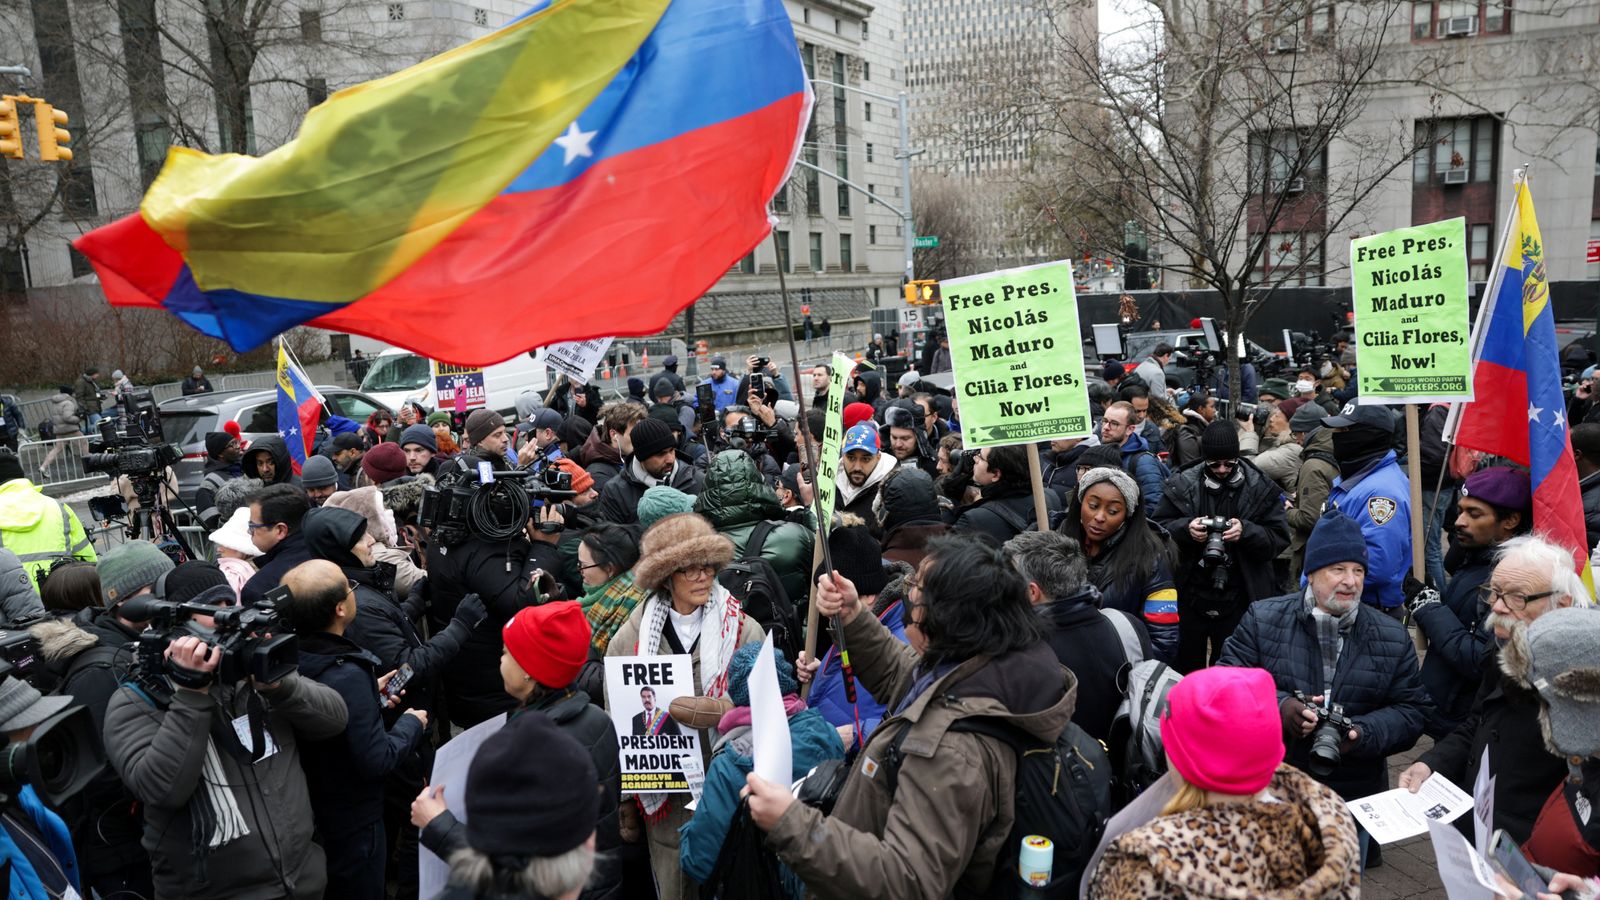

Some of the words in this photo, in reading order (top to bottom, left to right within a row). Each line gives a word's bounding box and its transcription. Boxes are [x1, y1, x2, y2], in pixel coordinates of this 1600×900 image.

[1357, 245, 1396, 262] Free
[1402, 237, 1453, 255] Pres.
[1371, 264, 1442, 286] Nicolás
[949, 292, 995, 311] Free
[1002, 282, 1058, 302] Pres.
[1371, 293, 1445, 313] Maduro
[904, 310, 918, 322] 15
[967, 309, 1048, 335] Nicolás
[1401, 315, 1418, 324] and
[1363, 331, 1399, 347] Cilia
[1402, 329, 1464, 346] Flores,
[557, 346, 586, 365] VENEZUELA
[970, 337, 1054, 361] Maduro
[1010, 361, 1027, 371] and
[1391, 353, 1436, 370] Now!
[965, 379, 1008, 397] Cilia
[1013, 373, 1079, 392] Flores,
[1394, 382, 1463, 391] WORKERS.ORG
[999, 397, 1050, 417] Now!
[1000, 423, 1031, 431] WORKERS
[1033, 419, 1057, 428] WORLD
[1059, 417, 1082, 426] PARTY
[1006, 423, 1083, 438] WORKERS.ORG
[622, 663, 674, 686] FREE
[620, 735, 694, 750] PRESIDENT
[625, 754, 691, 770] MADUR
[621, 773, 672, 781] BROOKLYN
[621, 781, 663, 789] AGAINST
[665, 781, 689, 789] WAR
